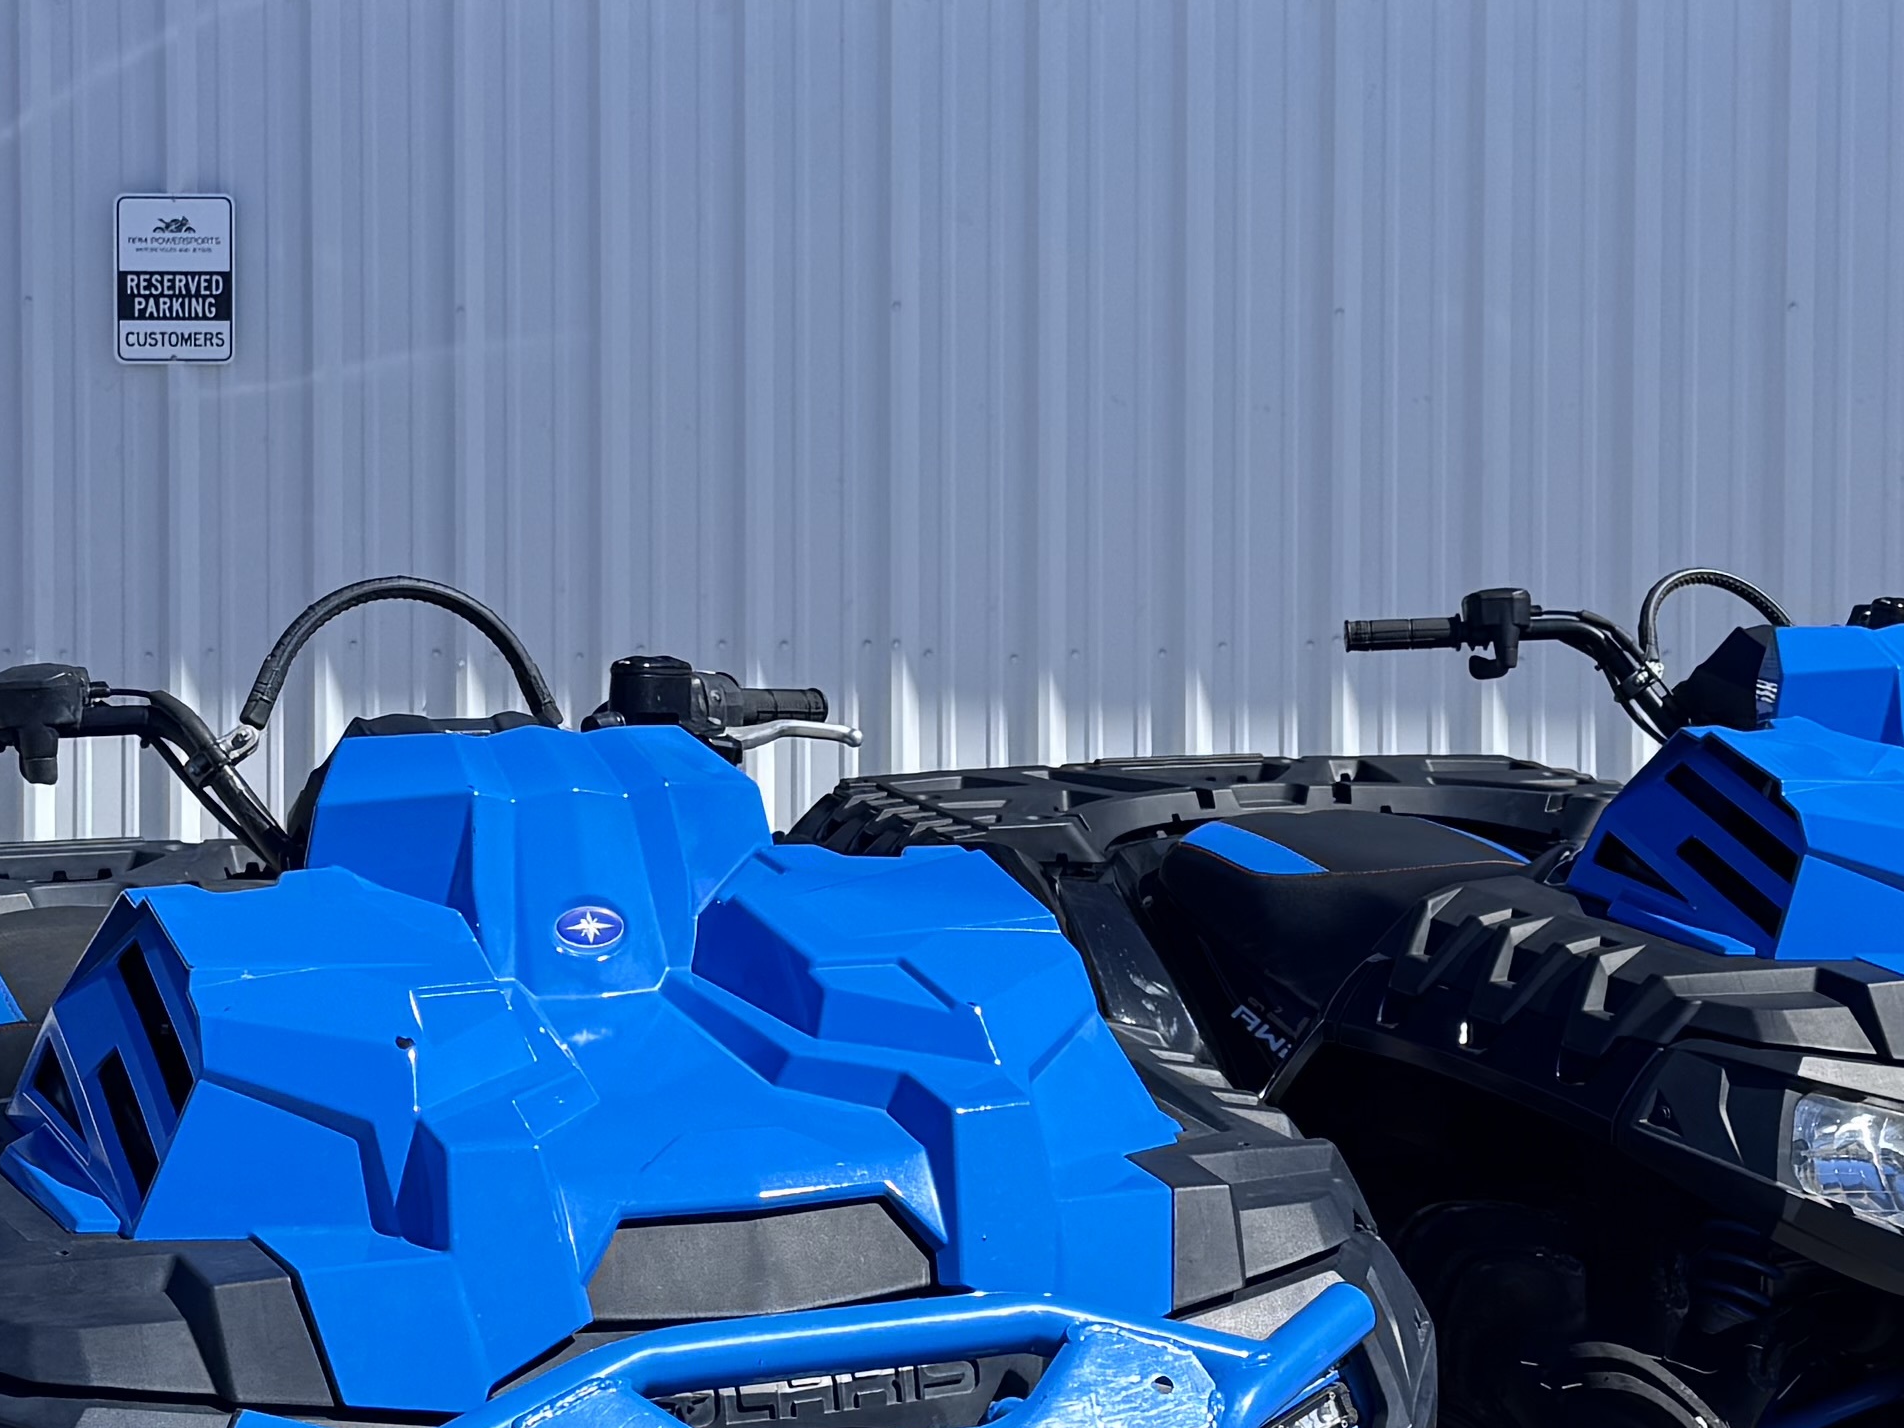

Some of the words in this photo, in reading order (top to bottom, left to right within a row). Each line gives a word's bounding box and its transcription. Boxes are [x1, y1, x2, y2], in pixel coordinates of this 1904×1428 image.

[126, 274, 223, 295] RESERVED
[134, 297, 216, 318] PARKING
[125, 331, 225, 348] CUSTOMERS
[1230, 1003, 1292, 1059] AW
[672, 1360, 980, 1428] OLARIS
